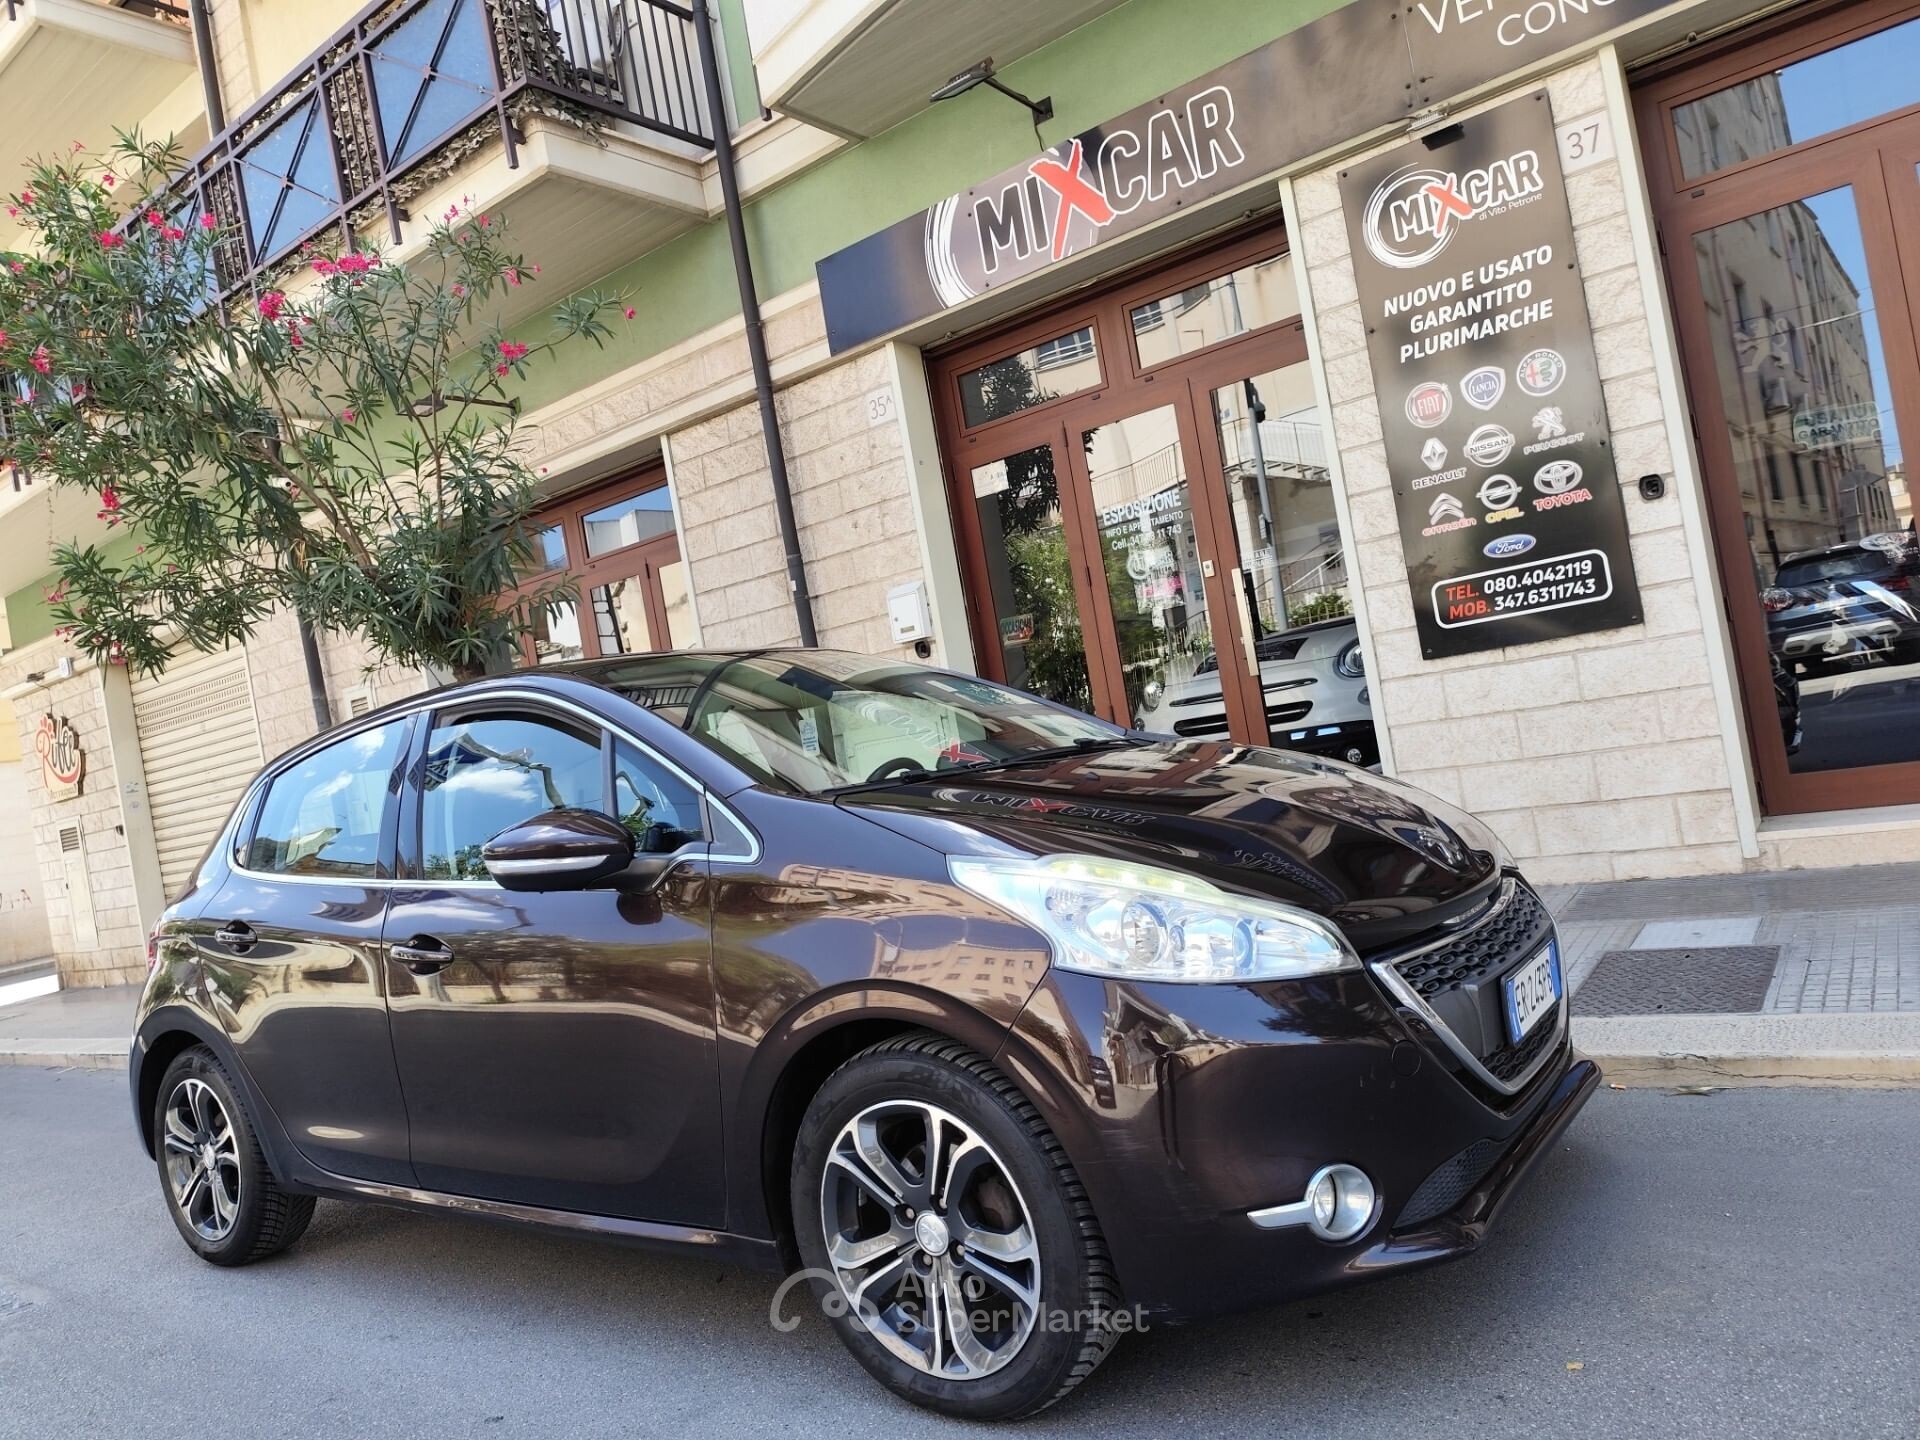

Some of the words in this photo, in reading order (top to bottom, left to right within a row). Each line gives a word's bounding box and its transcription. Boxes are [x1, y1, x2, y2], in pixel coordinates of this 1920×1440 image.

[1497, 0, 1615, 46] CON
[1566, 123, 1600, 160] 37
[974, 86, 1245, 275] MIXCAR
[1390, 150, 1544, 243] MIXCAR
[1479, 211, 1487, 222] di
[1488, 203, 1507, 218] Vito
[1508, 193, 1543, 212] Petrone
[1384, 277, 1456, 318] NUOVO
[1461, 270, 1476, 292] E
[1479, 245, 1553, 285] USATO
[1410, 279, 1532, 335] GARANTITO
[1400, 298, 1554, 364] PLURIMARCHE
[1417, 393, 1442, 416] FIAT
[1472, 380, 1497, 396] LANCIA
[1469, 437, 1510, 455] NISSAN
[1412, 467, 1467, 490] RENAULT
[1102, 489, 1182, 527] ESPOSIZIONE
[1533, 489, 1592, 512] TOYOTA
[1106, 527, 1122, 539] INFO
[1123, 525, 1130, 534] E
[1129, 511, 1184, 532] APPTAMENTO
[1168, 524, 1182, 537] 743
[1495, 539, 1525, 554] Ford
[1445, 583, 1480, 603] TEL.
[1483, 560, 1593, 595] 080.4042119
[1449, 600, 1491, 620] MOB.
[1494, 578, 1596, 612] 347.6311743
